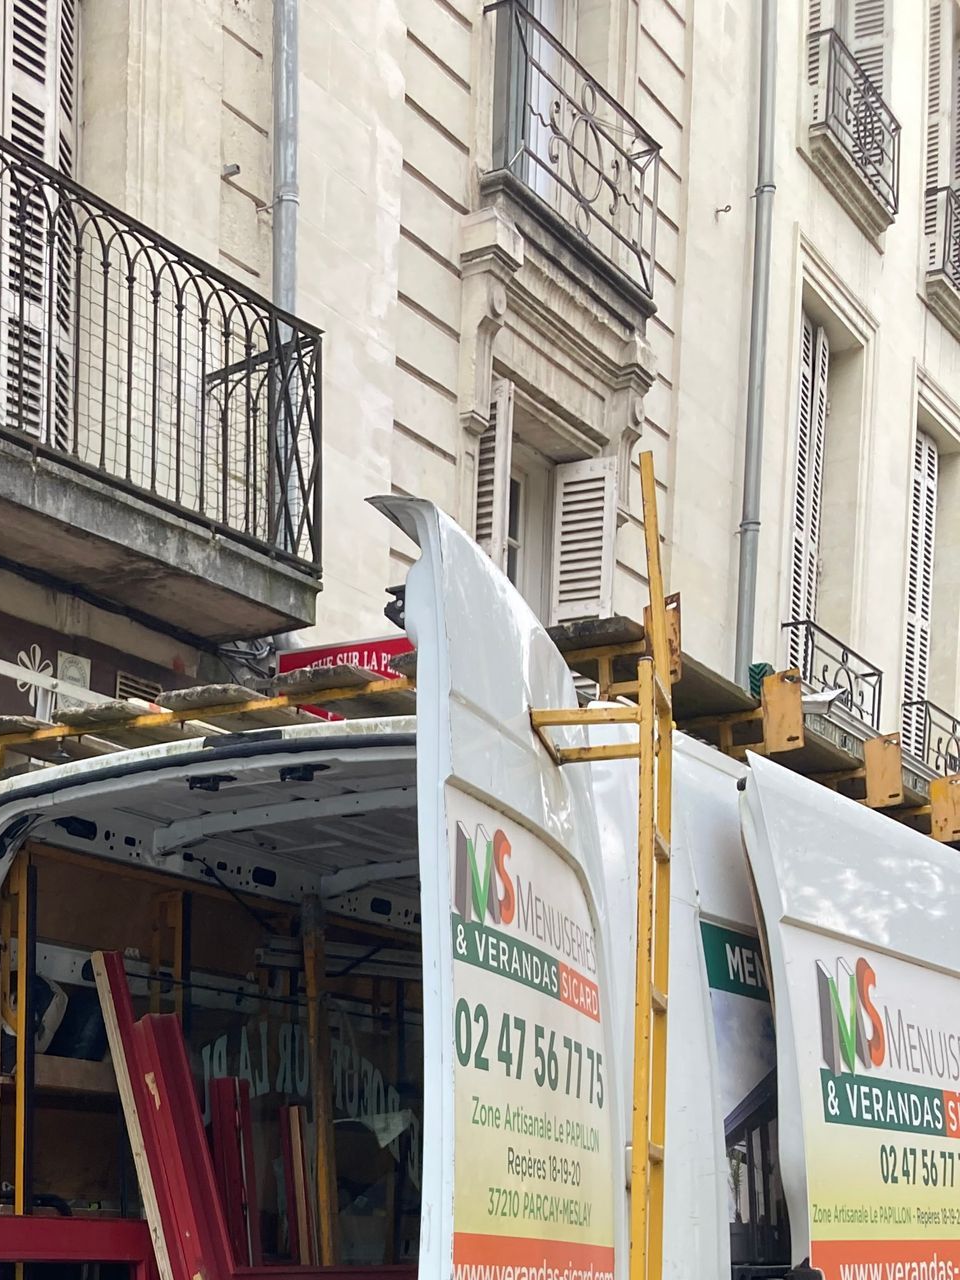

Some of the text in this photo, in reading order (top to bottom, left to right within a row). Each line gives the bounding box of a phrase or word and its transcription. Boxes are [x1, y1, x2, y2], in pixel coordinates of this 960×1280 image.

[363, 650, 378, 671] LA
[516, 874, 597, 975] MENUISERIES
[456, 923, 468, 956] &
[474, 930, 558, 993] VERANDAS
[455, 997, 604, 1110] 02 47 56 77 75
[884, 1005, 960, 1081] MENUIS
[471, 1095, 600, 1153] Zone Artisanale Le PAPILLON
[827, 1080, 840, 1116] &
[845, 1083, 943, 1131] VERANDAS
[507, 1147, 581, 1187] Repères 18-19-20
[880, 1144, 899, 1184] 02
[901, 1147, 917, 1185] 47
[921, 1148, 938, 1187] 56
[940, 1151, 954, 1188] 77
[487, 1187, 592, 1228] 37210 PARCAY-MESLAY
[812, 1203, 832, 1223] Zone
[833, 1204, 869, 1224] Artisanale
[870, 1205, 879, 1224] Le
[880, 1206, 912, 1225] PAPILLON
[941, 1207, 960, 1226] 18-19-2
